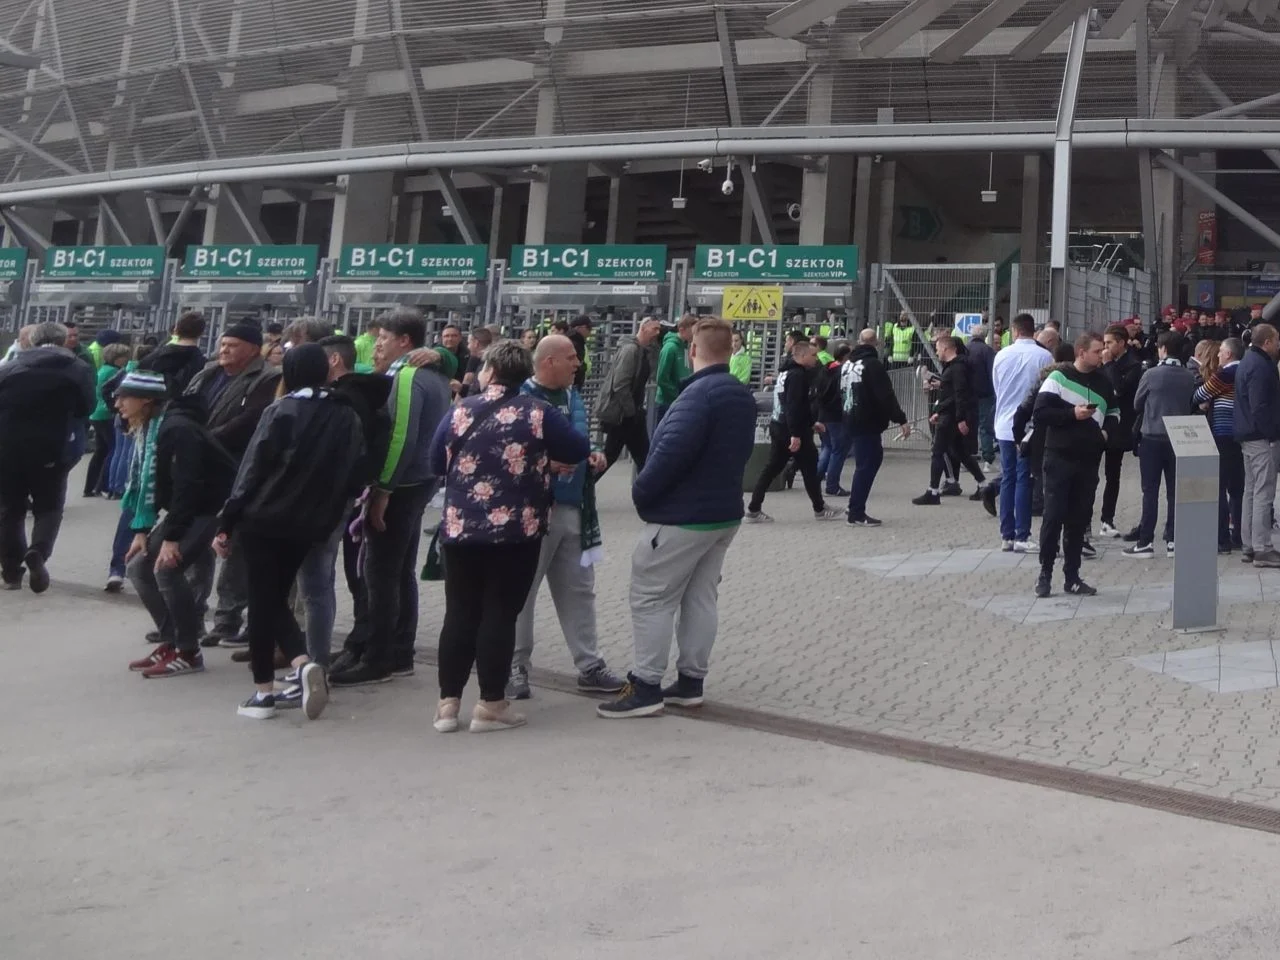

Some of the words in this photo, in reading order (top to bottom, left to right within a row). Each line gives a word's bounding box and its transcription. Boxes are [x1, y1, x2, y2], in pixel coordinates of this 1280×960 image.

[54, 249, 106, 267] B1-C1
[110, 258, 153, 267] SZEKTOR
[194, 248, 252, 267] B1-C1
[257, 257, 305, 267] SZEKTOR
[351, 247, 416, 267] B1-C1
[421, 257, 474, 267] SZEKTOR
[523, 248, 590, 268] B1-C1
[597, 258, 653, 268] SZEKTOR
[707, 248, 777, 268] B1-C1
[786, 259, 844, 268] SZEKTOR
